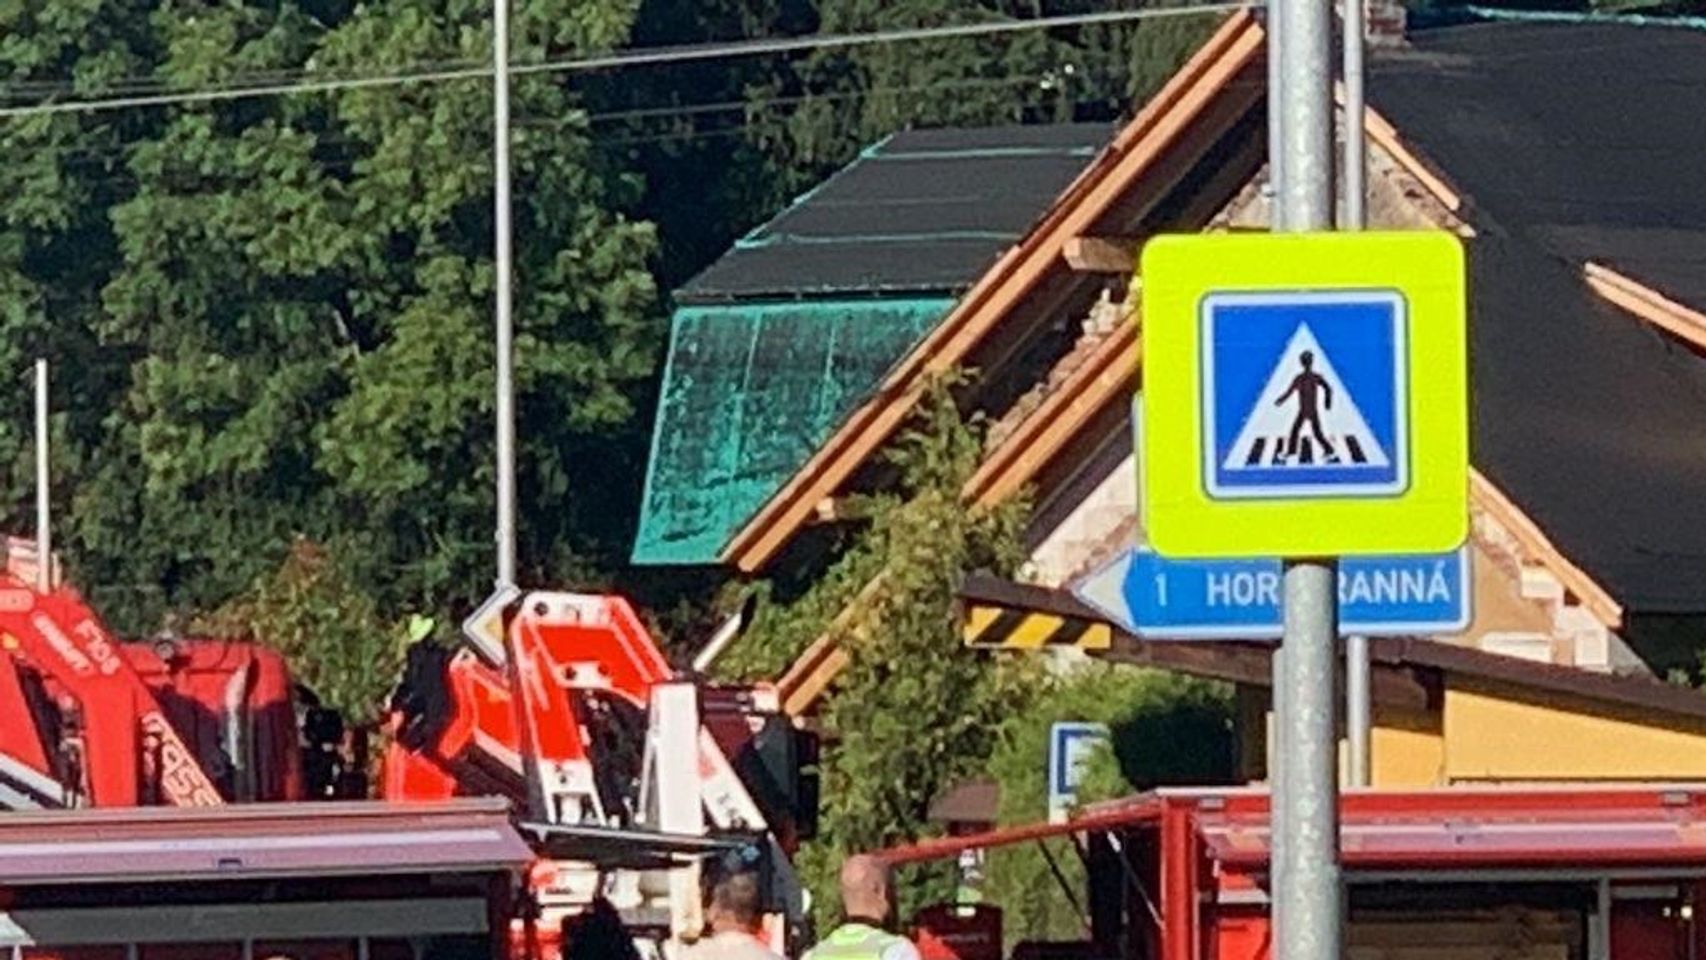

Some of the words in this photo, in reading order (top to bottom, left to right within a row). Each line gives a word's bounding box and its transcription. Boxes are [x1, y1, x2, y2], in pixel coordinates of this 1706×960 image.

[1154, 573, 1168, 607] 1
[1206, 572, 1280, 607] HOR
[1337, 560, 1450, 604] RANNÁ
